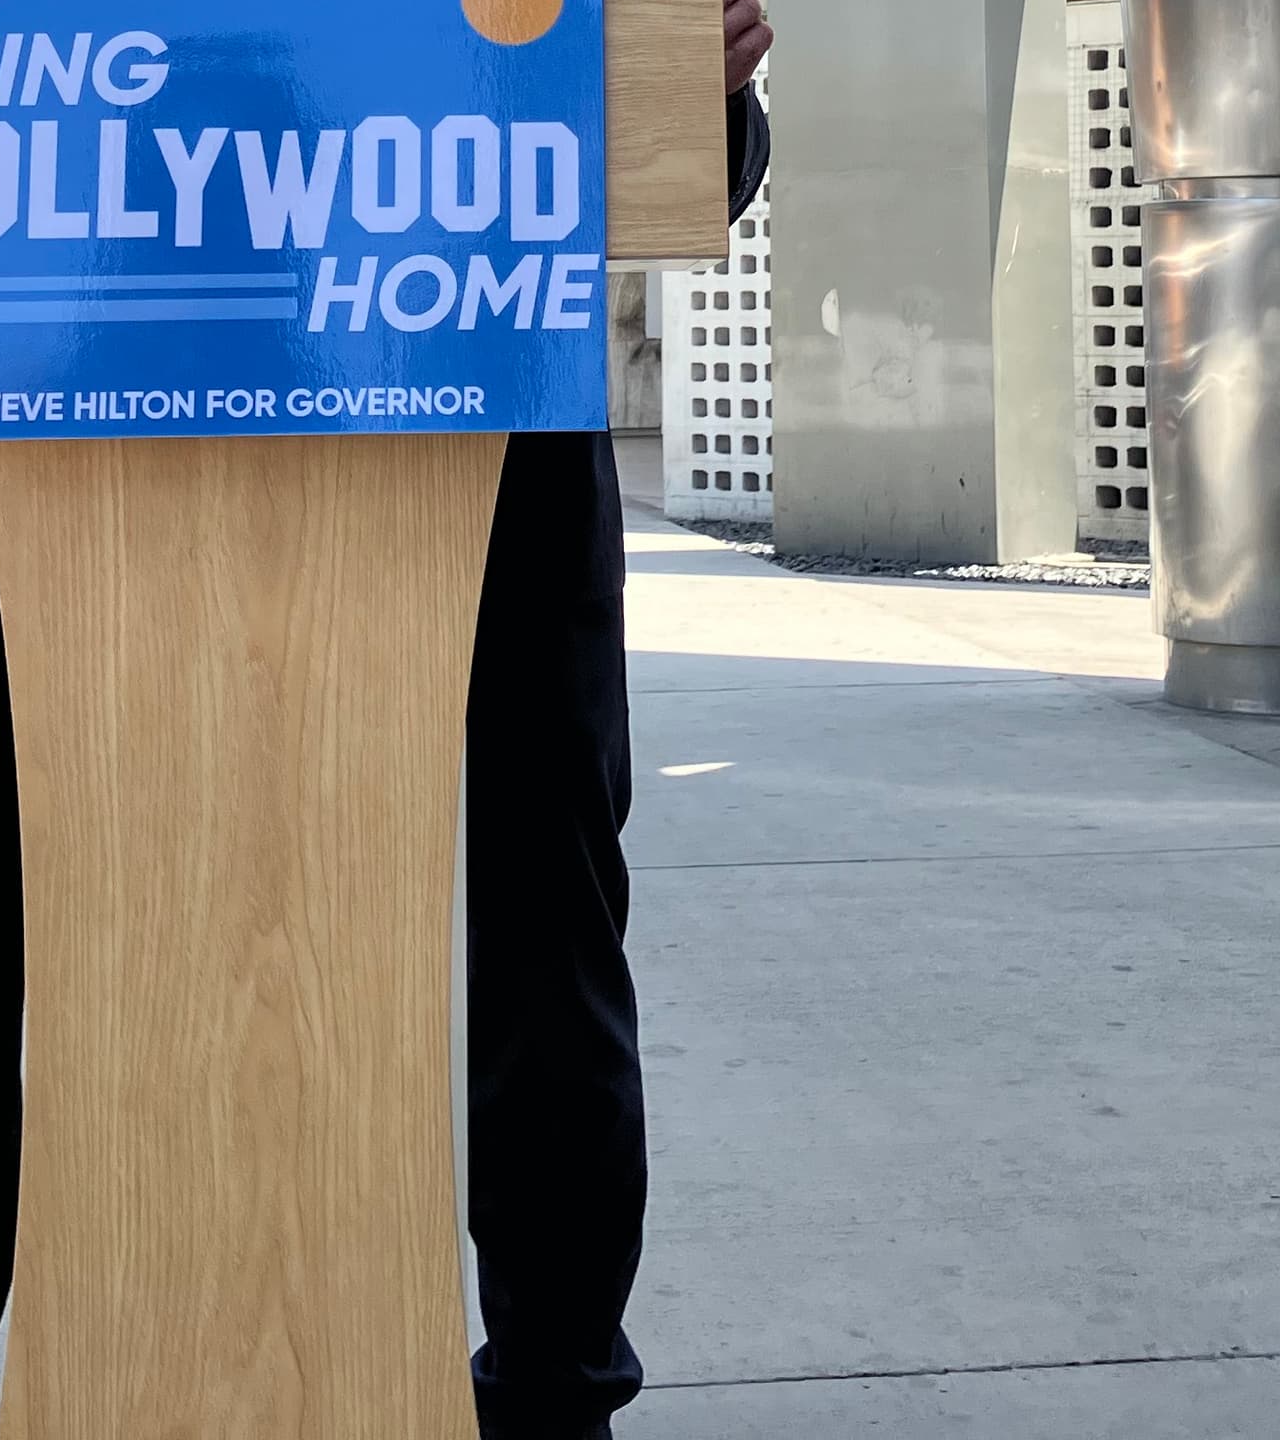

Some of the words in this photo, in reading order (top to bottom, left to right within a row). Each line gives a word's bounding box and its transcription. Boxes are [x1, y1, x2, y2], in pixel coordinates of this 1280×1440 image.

[307, 253, 601, 333] HOME
[74, 389, 196, 421] HILTON
[207, 388, 277, 419] FOR
[286, 385, 485, 418] GOVERNOR
